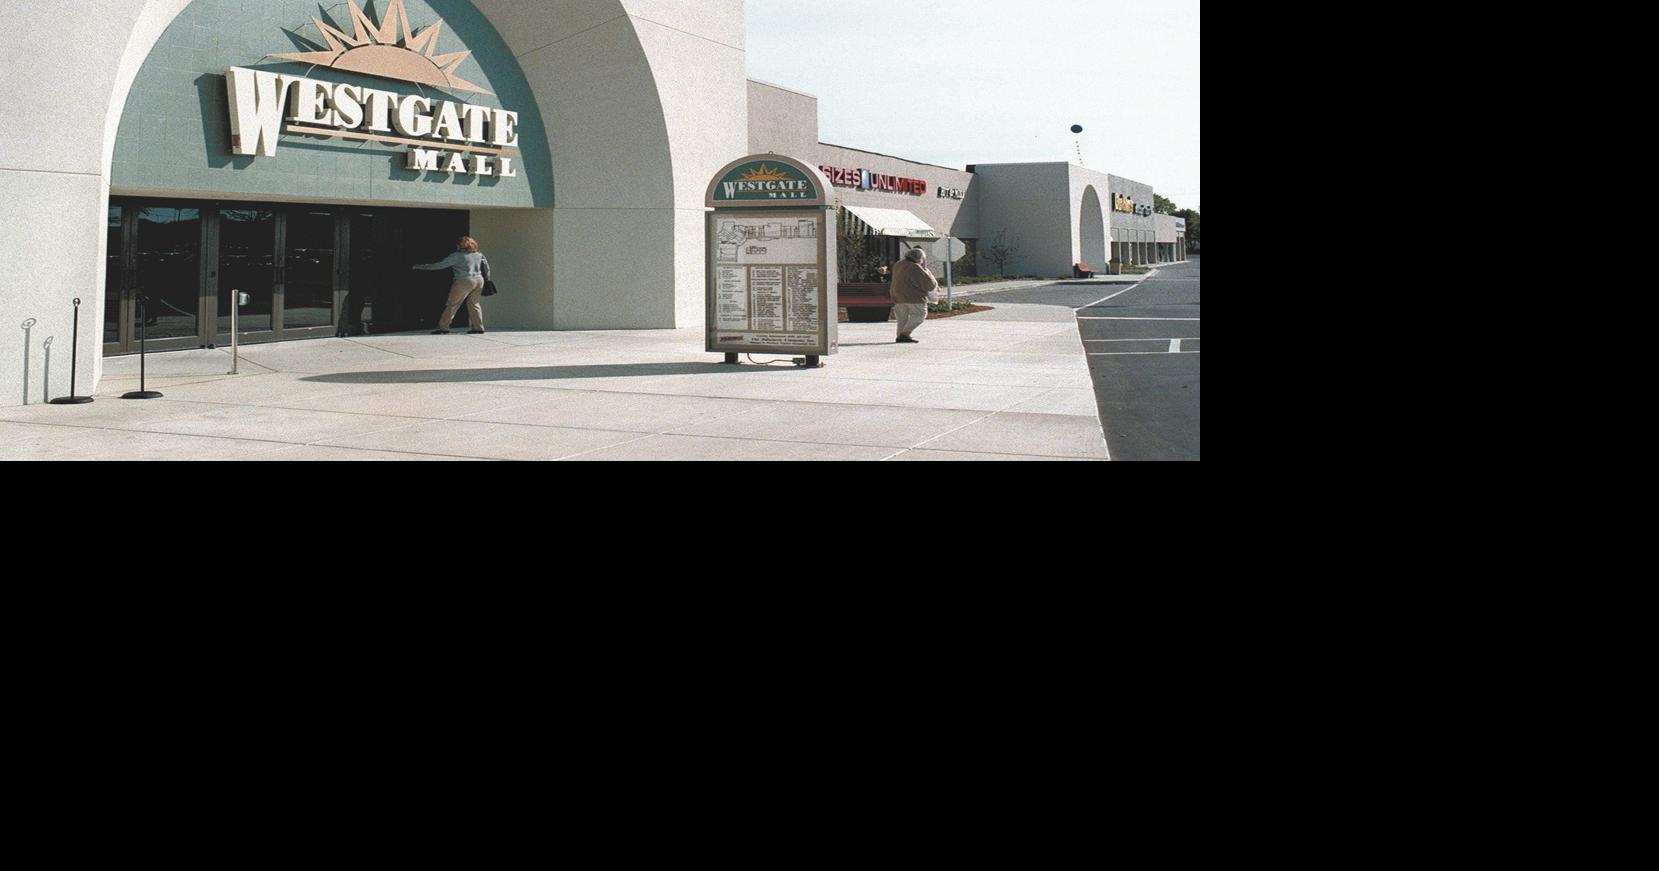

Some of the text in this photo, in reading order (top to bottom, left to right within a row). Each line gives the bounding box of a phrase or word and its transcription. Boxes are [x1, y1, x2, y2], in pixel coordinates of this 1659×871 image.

[226, 66, 519, 157] WESTGATE
[408, 148, 517, 178] MALL
[723, 180, 807, 199] WESTGATE
[821, 166, 861, 187] SIZES
[870, 172, 928, 195] UNLIMITED
